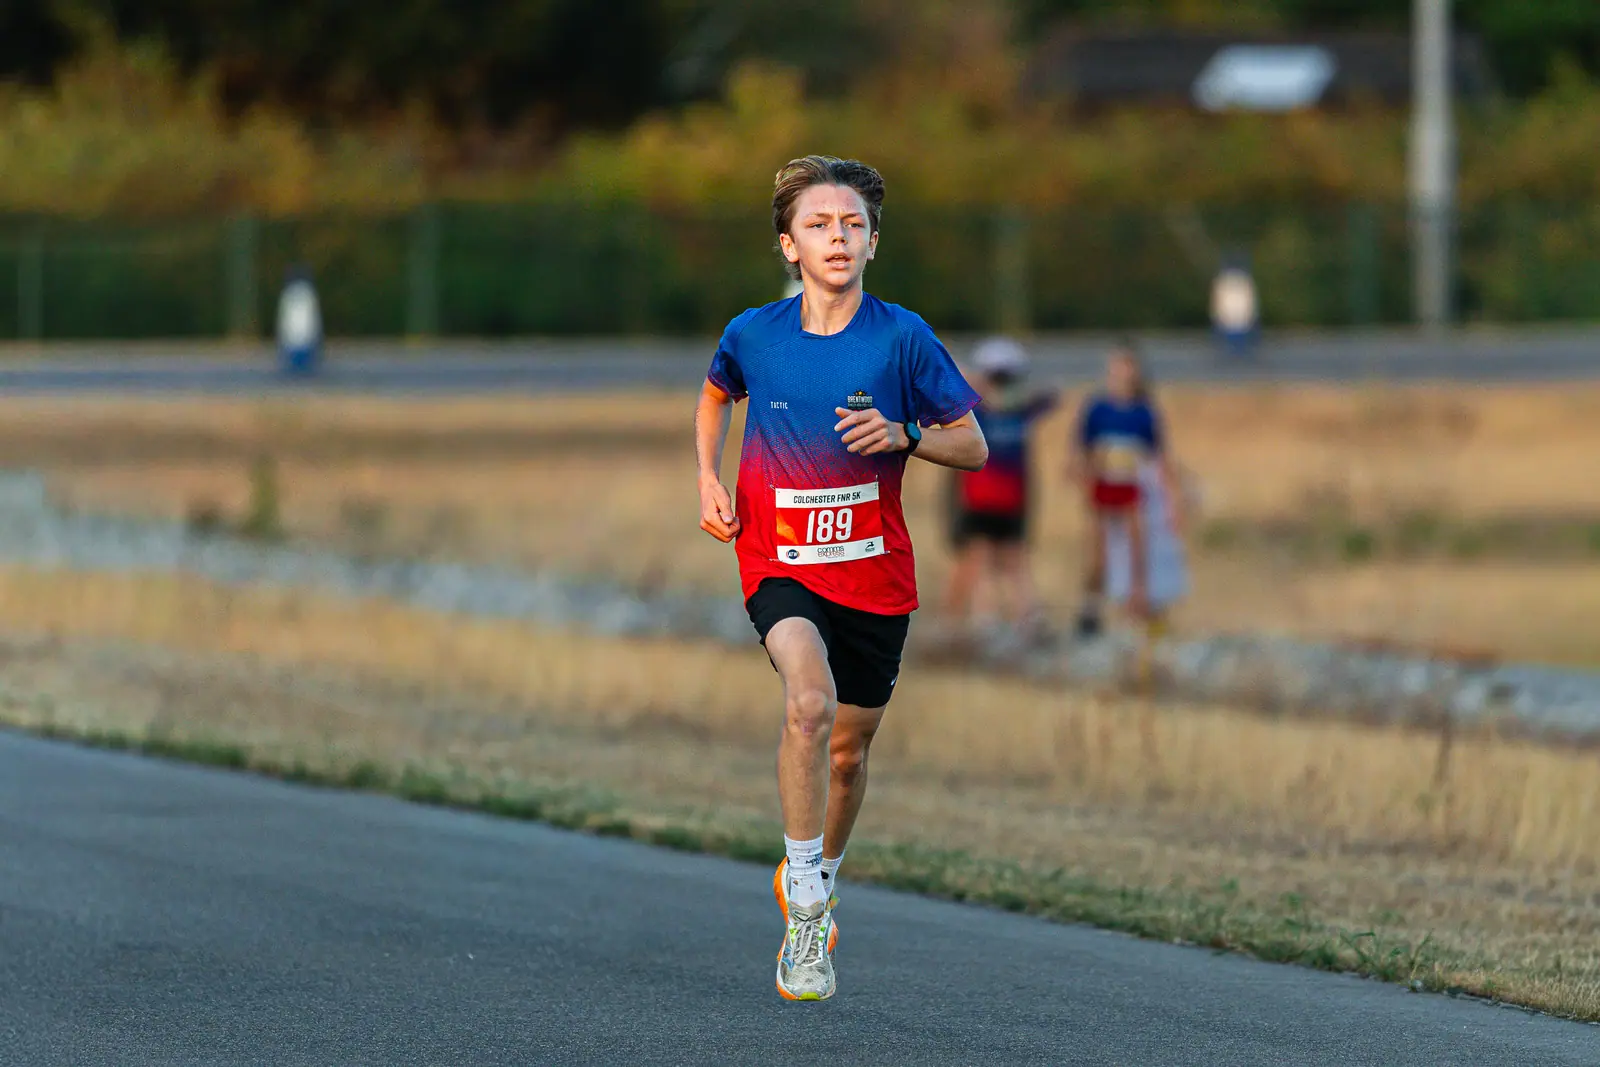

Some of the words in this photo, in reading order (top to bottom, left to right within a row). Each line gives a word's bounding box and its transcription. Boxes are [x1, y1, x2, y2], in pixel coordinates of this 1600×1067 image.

[770, 401, 788, 409] TACTIC
[793, 494, 835, 504] COLCHESTER
[837, 493, 851, 501] FNR
[852, 491, 861, 500] 5K
[806, 508, 853, 543] 189
